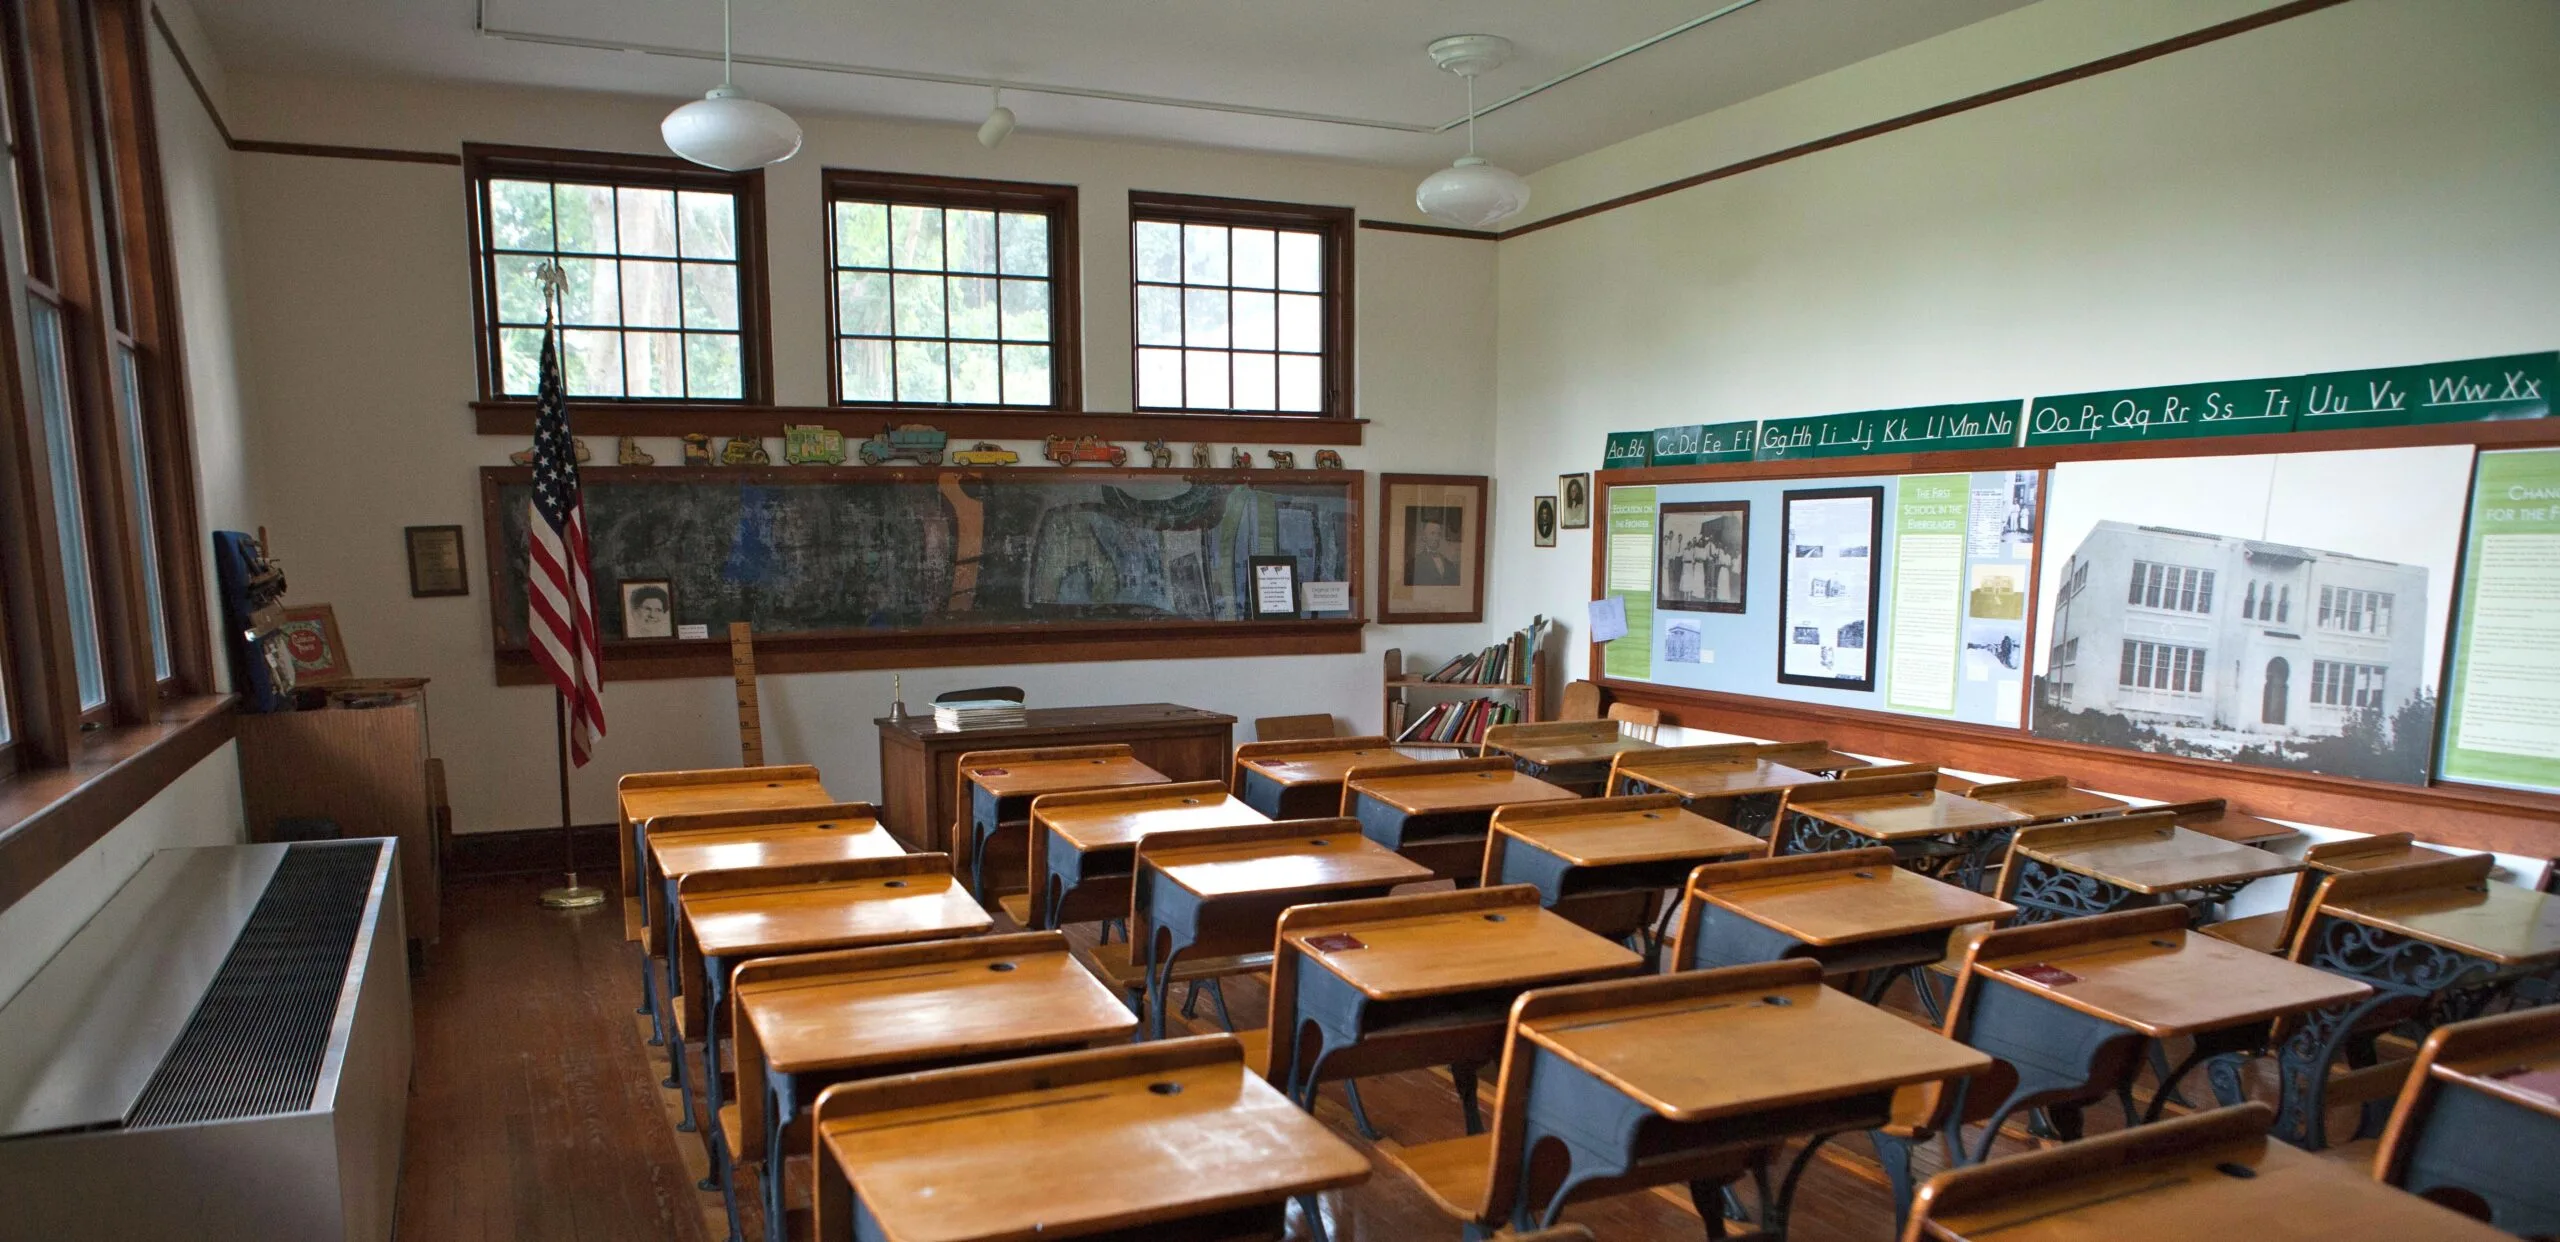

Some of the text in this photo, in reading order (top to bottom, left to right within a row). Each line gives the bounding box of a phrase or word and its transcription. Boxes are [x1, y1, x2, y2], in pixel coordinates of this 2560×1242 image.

[2035, 407, 2071, 433] Oo
[2111, 399, 2151, 436] Qq
[2163, 397, 2191, 424] Rr
[2202, 392, 2234, 421] Ss
[2264, 388, 2291, 417] Tt
[2308, 384, 2349, 415] Uu
[2369, 380, 2407, 410] Vv
[2429, 375, 2493, 405] Ww
[2500, 370, 2542, 400] Xx
[1607, 439, 1624, 458] Aa
[1627, 438, 1646, 458] Bb
[1656, 435, 1675, 456] Cc
[1679, 433, 1698, 454] Dd
[1703, 433, 1722, 453] Ee
[1734, 430, 1753, 451] Ff
[1763, 426, 1788, 456] Gg
[1790, 424, 1812, 447] Hh
[1851, 419, 1873, 451] Jj
[1883, 418, 1909, 442] Kk
[1984, 411, 2013, 435] Nn
[2486, 508, 2514, 521] FOR
[2520, 508, 2545, 521] THE
